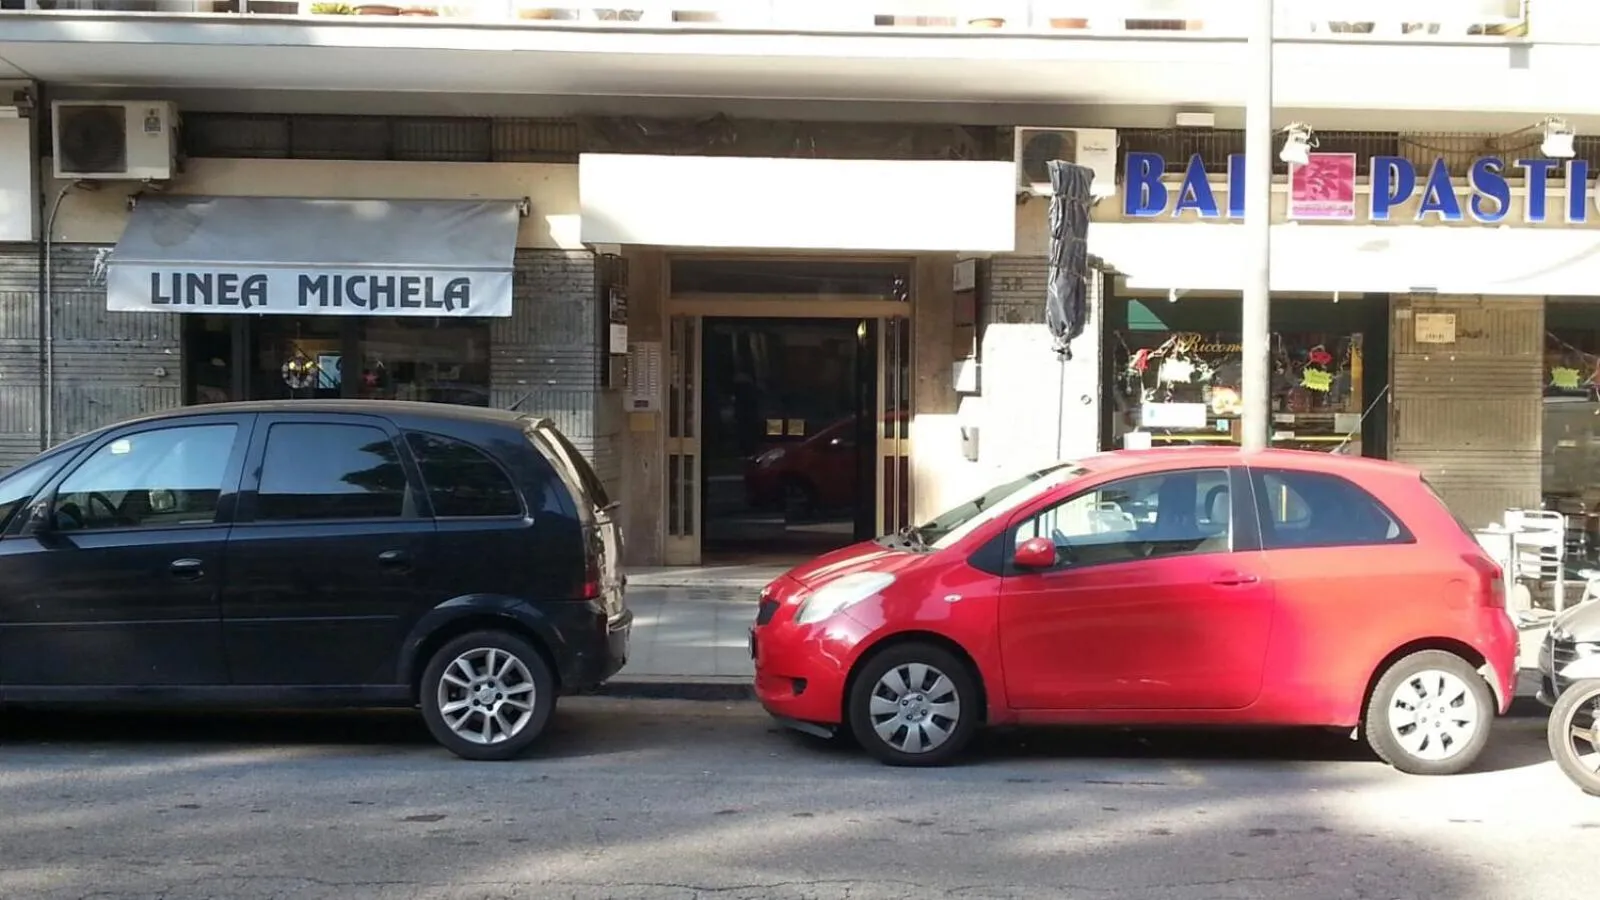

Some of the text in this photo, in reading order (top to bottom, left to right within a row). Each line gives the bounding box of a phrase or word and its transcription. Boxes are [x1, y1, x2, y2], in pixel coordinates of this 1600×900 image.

[1370, 155, 1600, 224] PASTI
[151, 272, 471, 311] LINEA MICHELA
